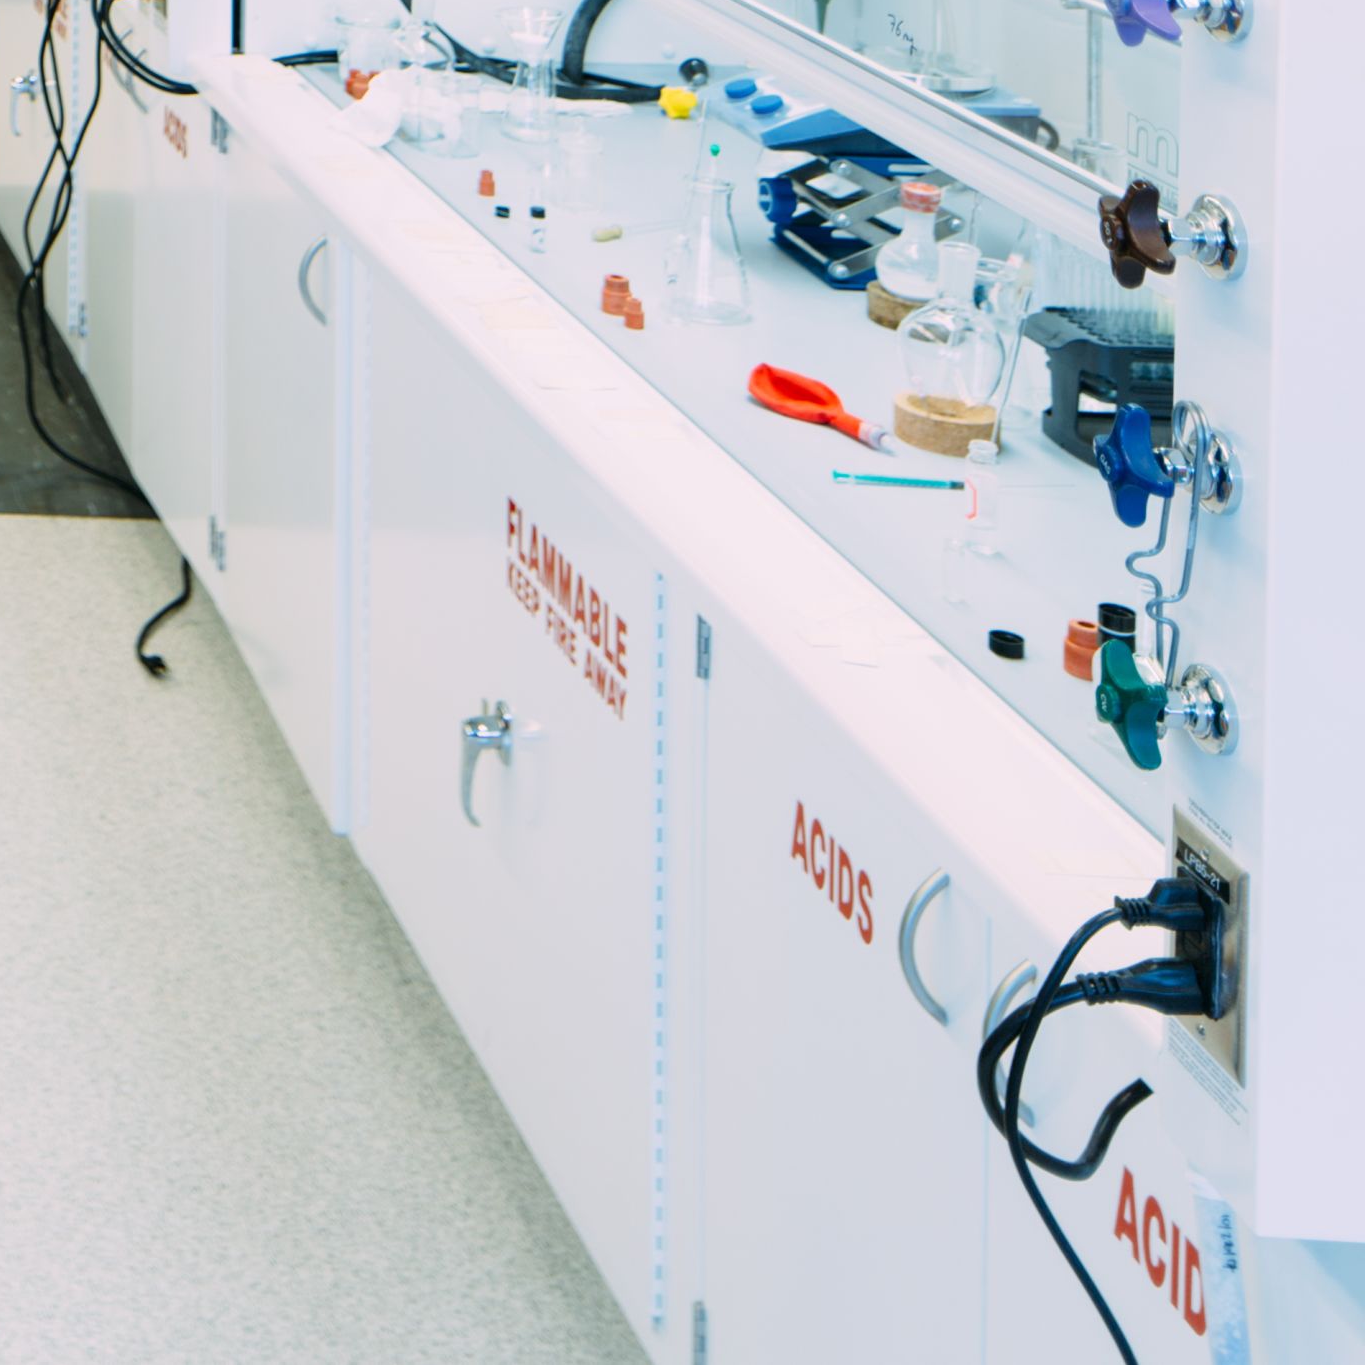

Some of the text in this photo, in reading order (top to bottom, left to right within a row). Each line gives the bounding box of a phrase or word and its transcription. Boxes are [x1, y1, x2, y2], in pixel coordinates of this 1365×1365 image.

[507, 496, 627, 679] FLAMMABLE
[507, 556, 627, 721] KEEP FIRE AWAY
[791, 800, 873, 946] ACIDS
